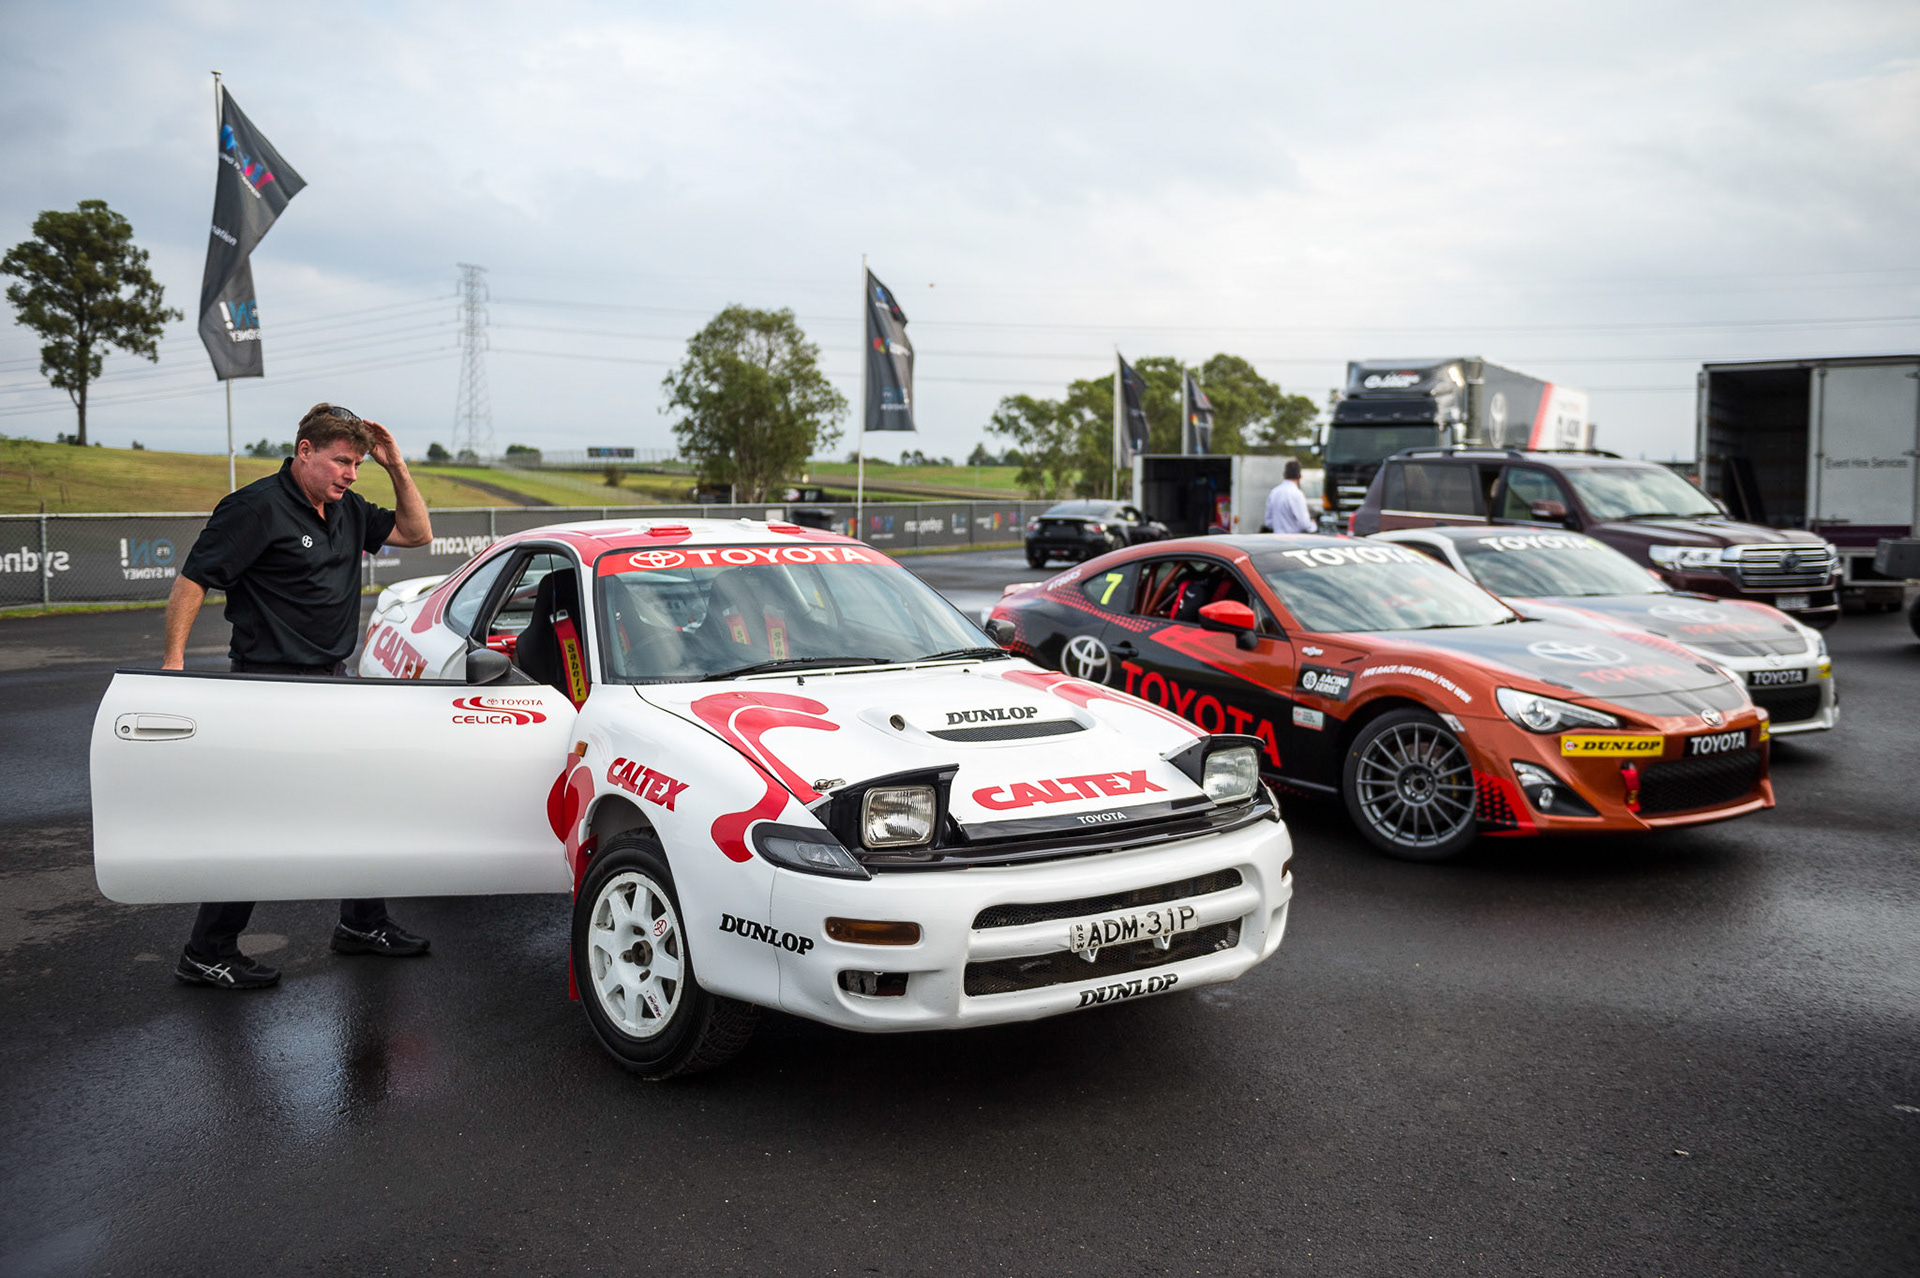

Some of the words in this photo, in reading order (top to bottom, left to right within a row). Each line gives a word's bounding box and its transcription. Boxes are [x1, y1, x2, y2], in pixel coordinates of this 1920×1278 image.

[1826, 458, 1850, 469] Event
[1852, 458, 1869, 468] Hire
[1872, 457, 1908, 469] Services
[1478, 534, 1594, 552] TOYOTA
[686, 547, 872, 565] TOYOTA
[1282, 547, 1424, 568] TOYOTA
[1100, 573, 1124, 605] 7
[1319, 674, 1350, 688] RACING
[1752, 670, 1803, 684] TOYOTA
[1314, 682, 1340, 695] SERIES
[1453, 687, 1472, 704] WIN
[452, 715, 512, 724] CELICA
[946, 706, 1038, 725] DUNLOP
[1121, 660, 1282, 769] TOYOTA
[1582, 740, 1660, 750] DUNLOP
[1690, 731, 1746, 755] TOYOTA
[607, 757, 690, 812] CALTEX
[972, 770, 1168, 810] CALTEX
[1077, 811, 1127, 824] TOYOTA
[719, 913, 814, 955] DUNLOP
[1075, 973, 1179, 1009] DUNLOP
